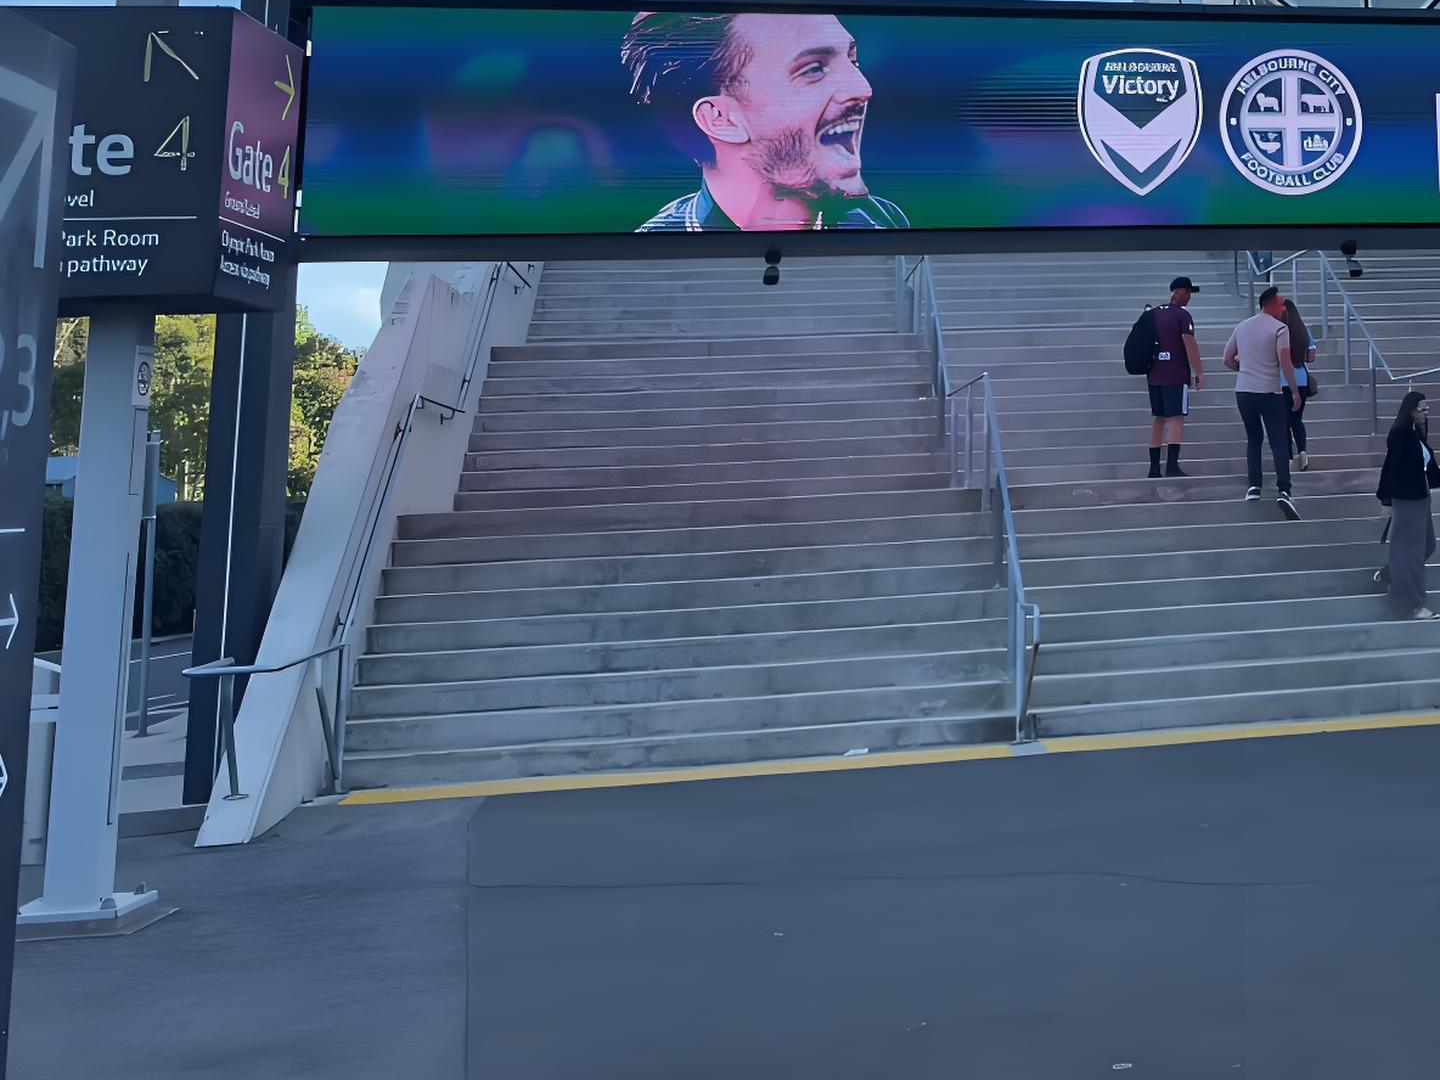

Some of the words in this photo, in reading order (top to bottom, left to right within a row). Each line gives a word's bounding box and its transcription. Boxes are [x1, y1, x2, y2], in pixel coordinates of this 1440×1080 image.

[1102, 74, 1180, 101] Victory
[1318, 68, 1346, 96] CITY
[68, 123, 135, 177] te
[154, 115, 196, 171] 4
[228, 120, 273, 194] Gate
[277, 144, 291, 200] 4
[1239, 151, 1312, 188] FOOTBALL
[1312, 151, 1345, 182] CLUB
[64, 189, 94, 208] vel
[102, 228, 160, 247] Room
[67, 254, 148, 278] pathway
